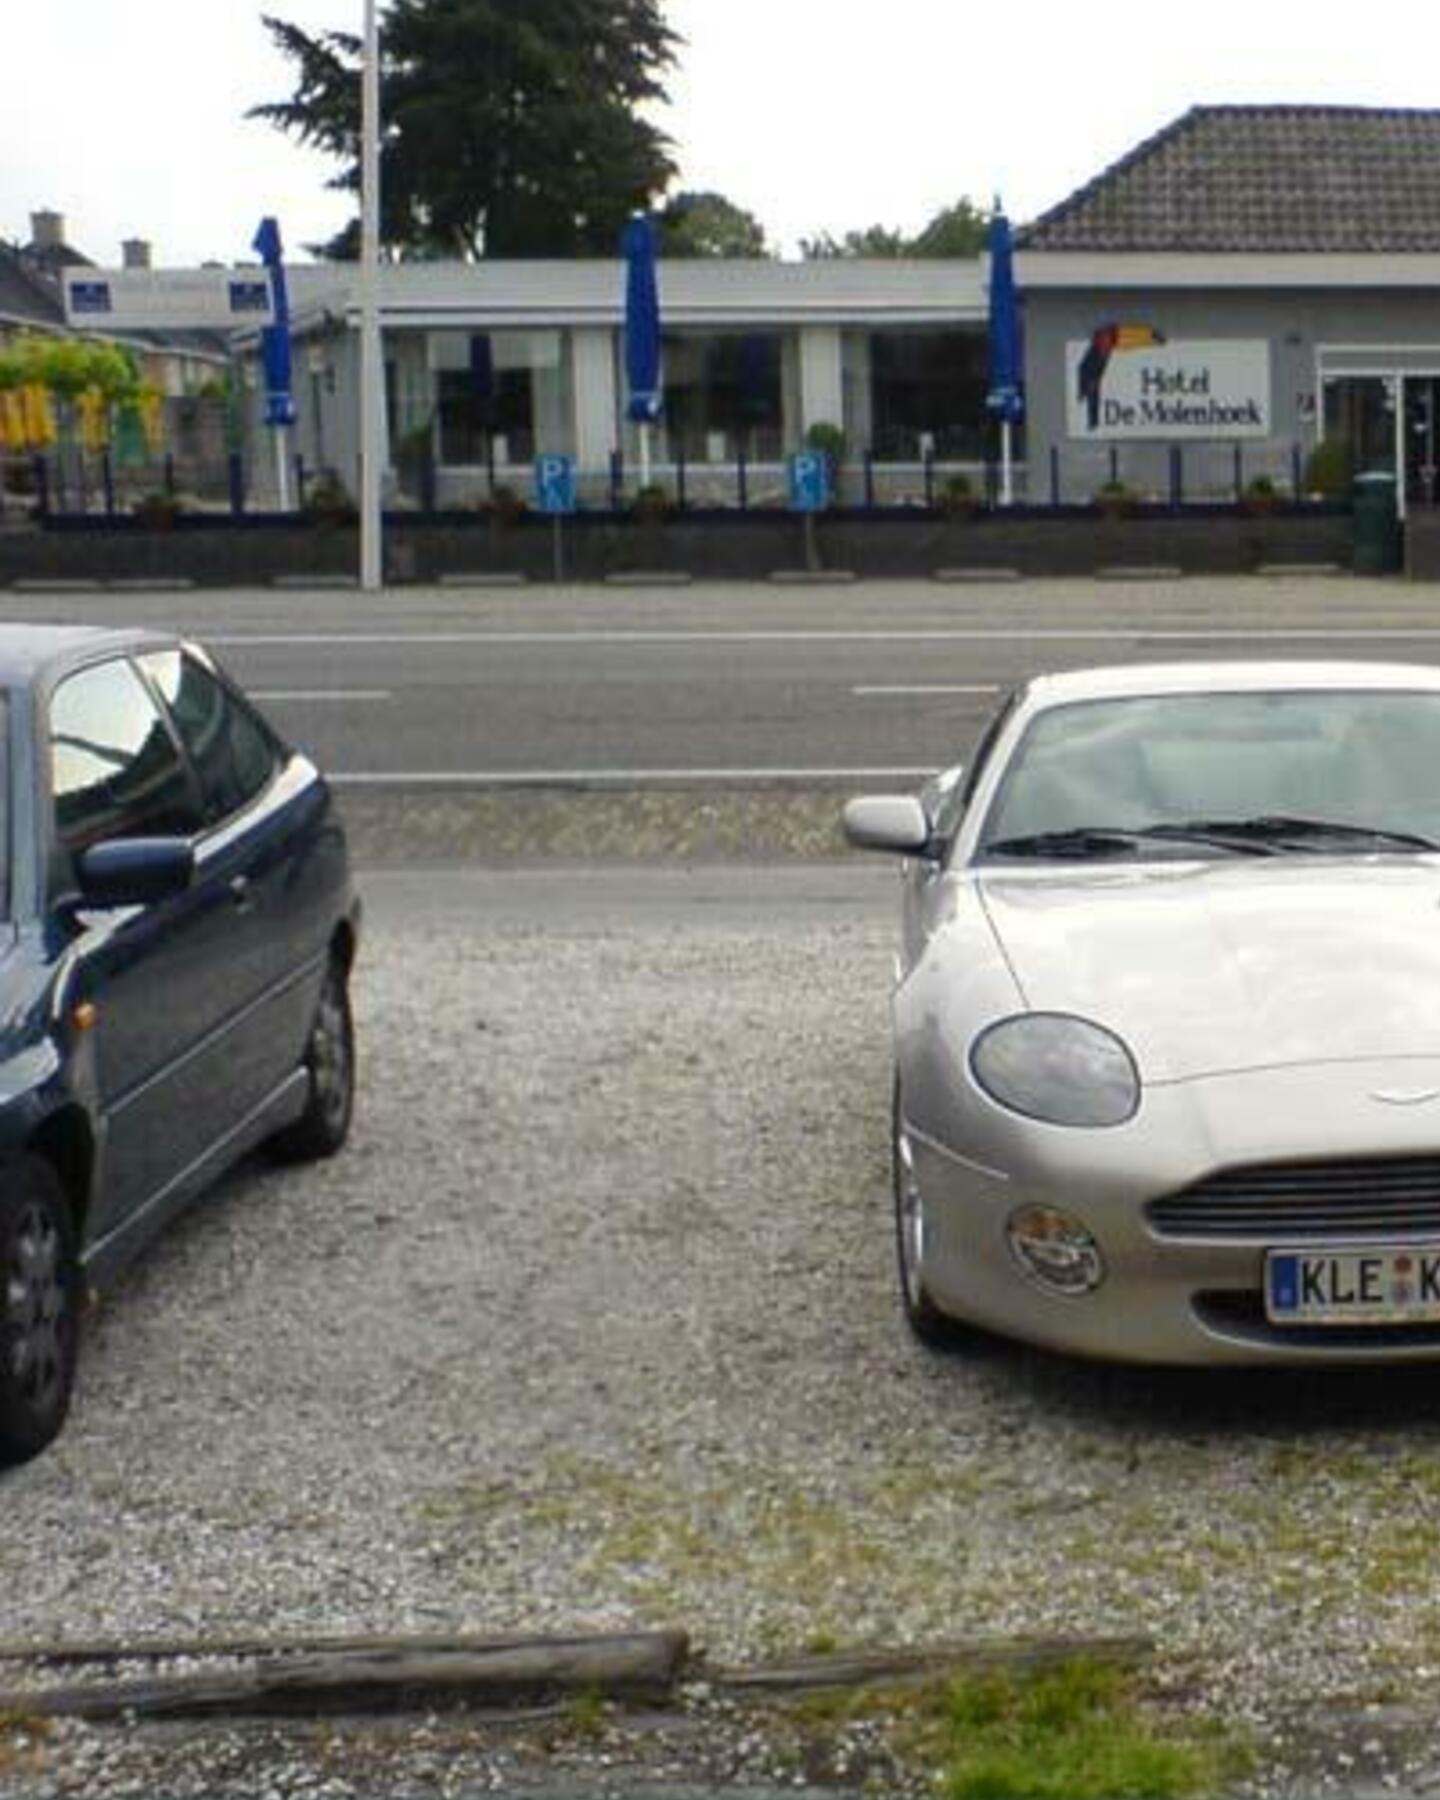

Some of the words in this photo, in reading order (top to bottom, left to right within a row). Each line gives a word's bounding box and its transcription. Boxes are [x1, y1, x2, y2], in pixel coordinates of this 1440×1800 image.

[1141, 367, 1210, 394] Hotel
[1105, 400, 1135, 425] De
[1140, 398, 1262, 425] Molenhoek
[543, 458, 563, 487] P
[796, 456, 817, 484] P
[1302, 1259, 1383, 1304] KLE
